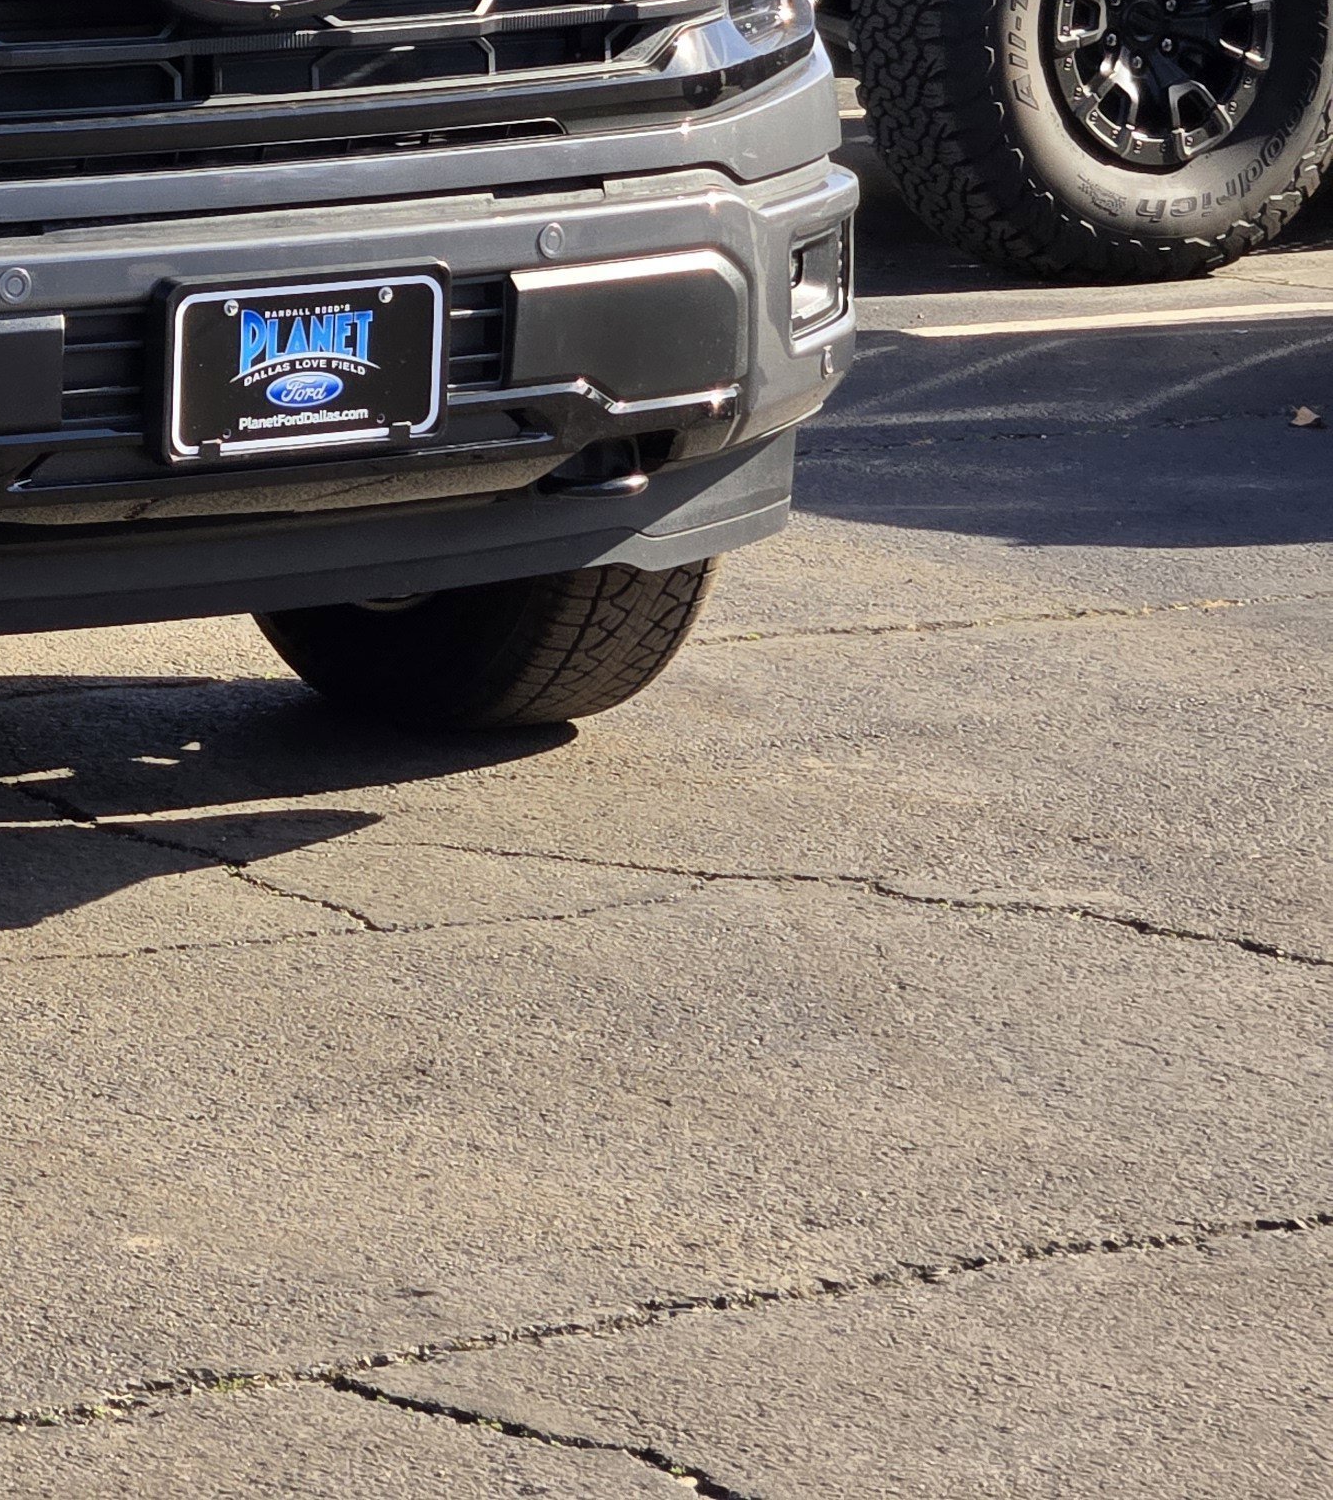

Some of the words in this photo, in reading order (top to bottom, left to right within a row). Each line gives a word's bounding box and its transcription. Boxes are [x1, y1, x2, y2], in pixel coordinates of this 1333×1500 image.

[240, 305, 374, 375] PLANET
[243, 362, 291, 387] DALLAS
[295, 359, 328, 369] LOVE
[331, 360, 366, 376] FIELD
[281, 376, 329, 401] Ford
[239, 408, 369, 431] PlanetFordDallas.com
